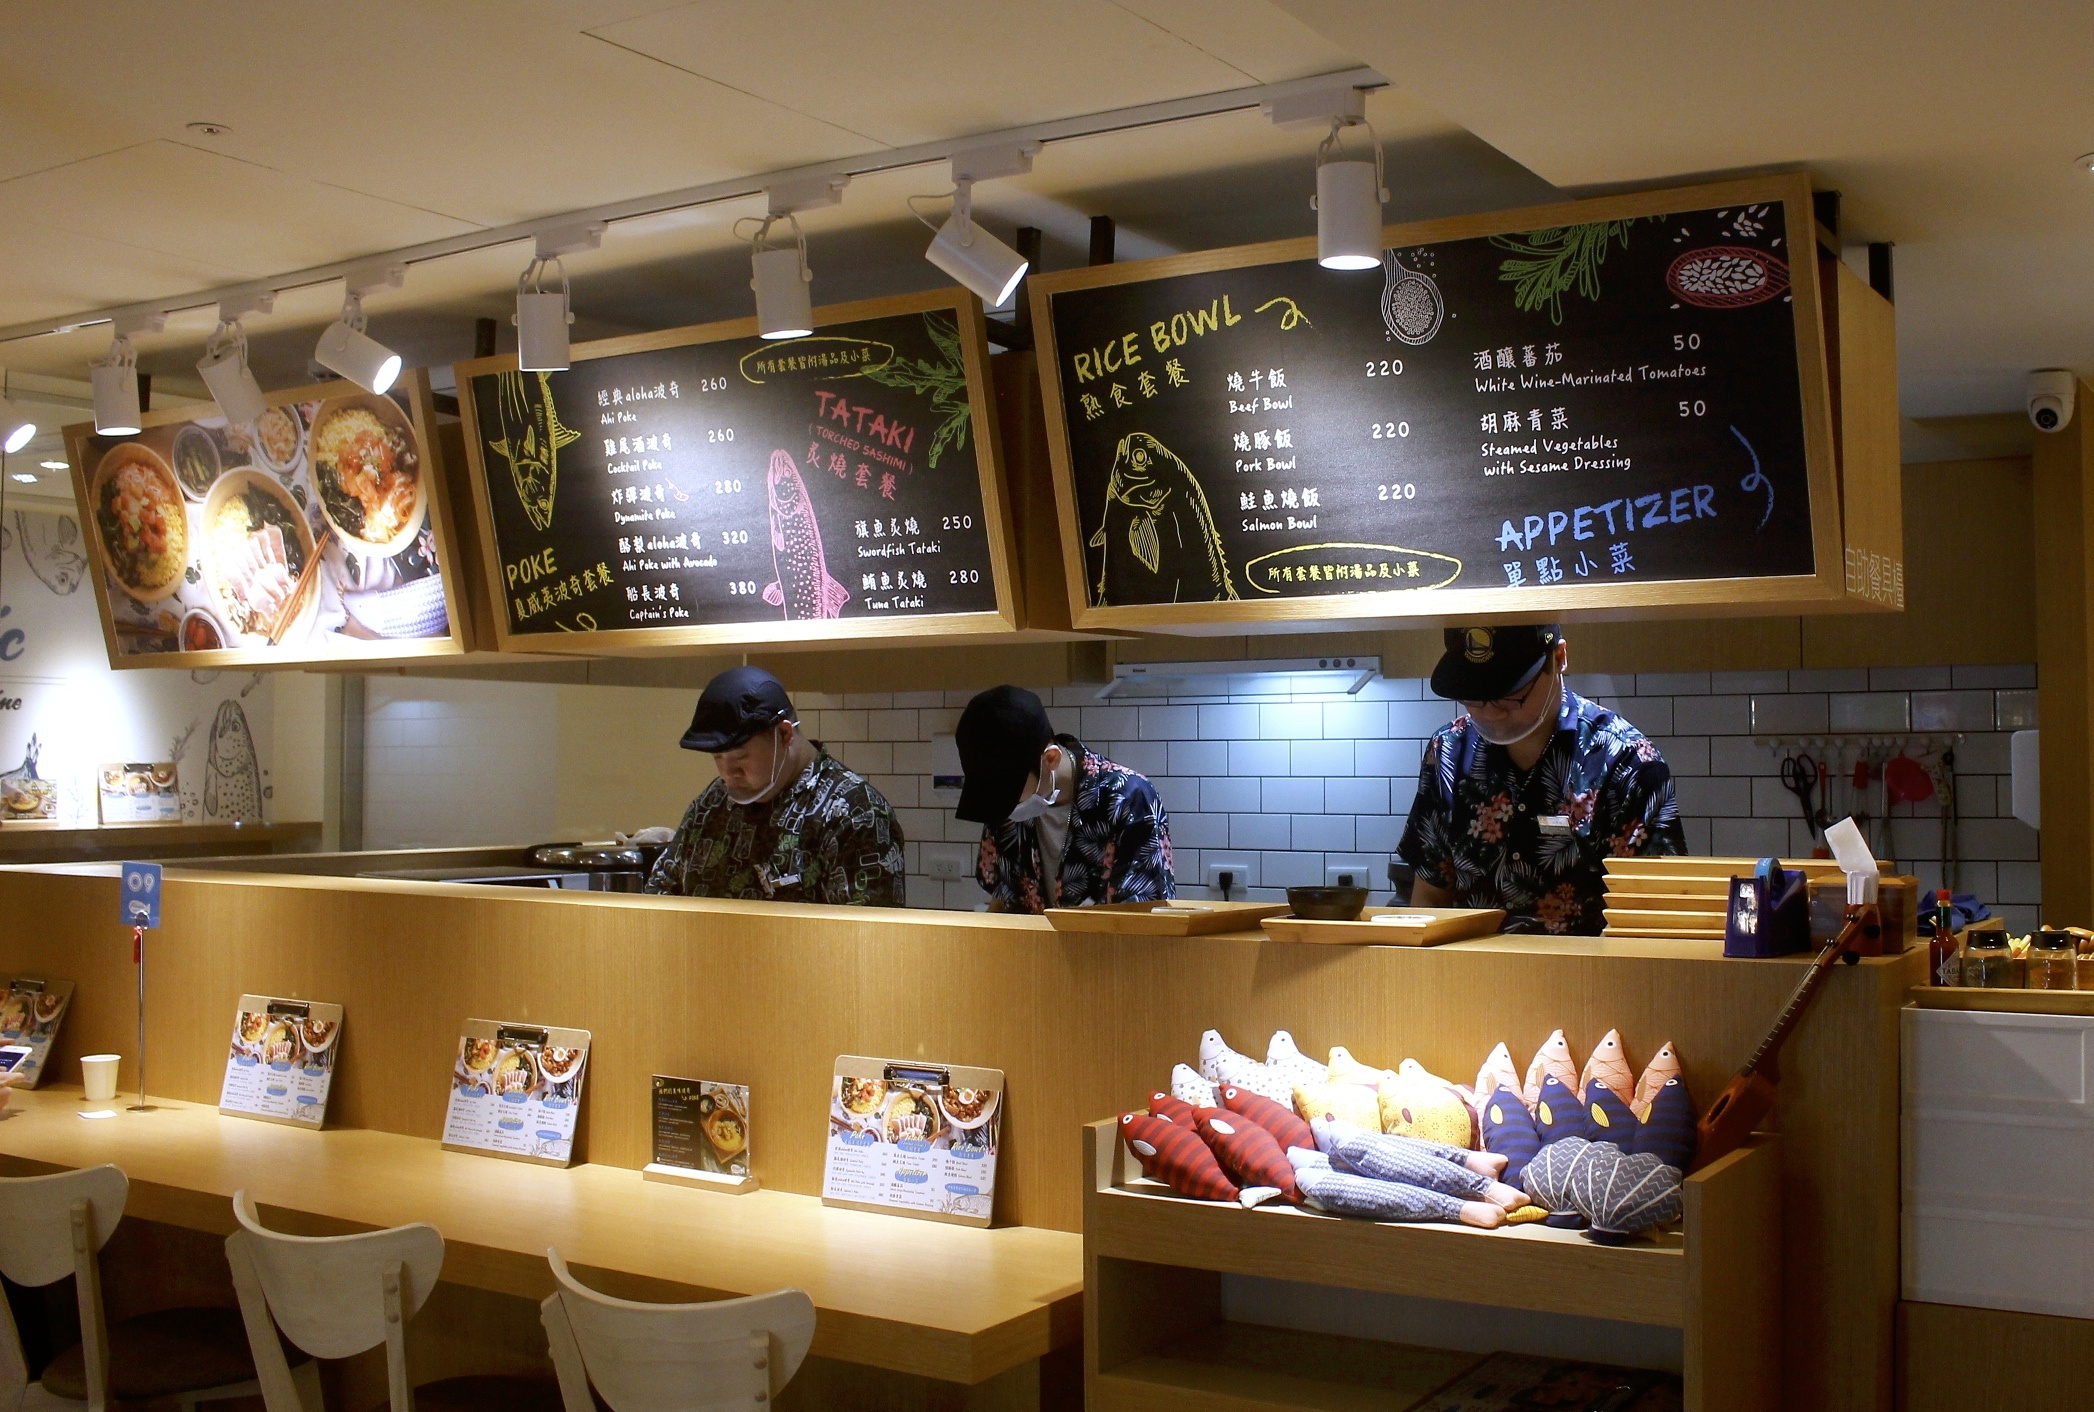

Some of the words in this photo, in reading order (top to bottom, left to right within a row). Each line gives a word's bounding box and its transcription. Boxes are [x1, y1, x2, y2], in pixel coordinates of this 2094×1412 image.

[1074, 333, 1142, 383] RICE
[1151, 294, 1243, 353] BOWL
[1673, 334, 1701, 351] 50
[1474, 342, 1563, 370] 酒釀蕃茄
[1366, 360, 1403, 377] 220
[1475, 375, 1515, 393] White
[1520, 368, 1633, 389] Wine-Marinated
[1638, 364, 1706, 380] Tomatoes
[701, 377, 727, 392] 260
[1079, 358, 1190, 420] 熟食套餐
[1226, 368, 1288, 393] 燒牛飯
[1229, 399, 1259, 414] Beef
[1264, 395, 1293, 412] Bowl
[1679, 401, 1706, 417] 50
[601, 414, 614, 425] Ahi
[617, 412, 637, 423] Poke
[815, 390, 914, 453] TATAKI
[1480, 407, 1569, 433] 胡麻青菜
[708, 429, 734, 442] 260
[1233, 429, 1293, 452] 燒豚飯
[1372, 422, 1410, 439] 220
[603, 433, 672, 457] 雞尾酒波奇
[1481, 440, 1537, 457] Steamed
[1543, 436, 1618, 456] Vegetables
[607, 461, 640, 474] Cocktail
[642, 460, 662, 470] Poke
[805, 441, 897, 501] 炙燒套餐
[1235, 458, 1263, 473] Pork
[1267, 456, 1296, 471] Bowl
[1484, 461, 1514, 476] with
[1519, 458, 1568, 474] Sesame
[1574, 454, 1631, 473] Dressing
[611, 484, 665, 505] 炸彈波奇
[715, 480, 741, 494] 280
[1378, 484, 1416, 501] 220
[1239, 488, 1321, 511] 鮭魚燒飯
[614, 511, 653, 526] Dynamite
[656, 509, 676, 520] Poke
[942, 515, 972, 530] 250
[1242, 516, 1283, 532] Salmon
[1288, 514, 1317, 531] Bowl
[1495, 484, 1717, 551] APPETIZER
[722, 531, 748, 544] 320
[855, 518, 920, 539] 旗魚炙燒
[858, 543, 905, 559] Swordfish
[908, 540, 941, 554] Tataki
[507, 547, 558, 590] POKE
[623, 560, 636, 572] Ahi
[639, 559, 659, 570] Poke
[661, 558, 680, 569] with
[683, 555, 718, 568] Avocado
[1268, 563, 1421, 583] 所有套餐皆附湯品及小菜
[1504, 542, 1636, 588] 單點小菜
[862, 571, 928, 591] 鮪魚炙燒
[949, 569, 979, 584] 280
[515, 562, 614, 621] 夏威夷波奇套餐
[626, 582, 680, 602] 船長波奇
[729, 580, 756, 595] 380
[865, 597, 889, 610] Tuna
[891, 595, 924, 608] Tataki
[629, 606, 667, 621] Captain's
[669, 608, 689, 618] Poke
[127, 871, 156, 893] 09
